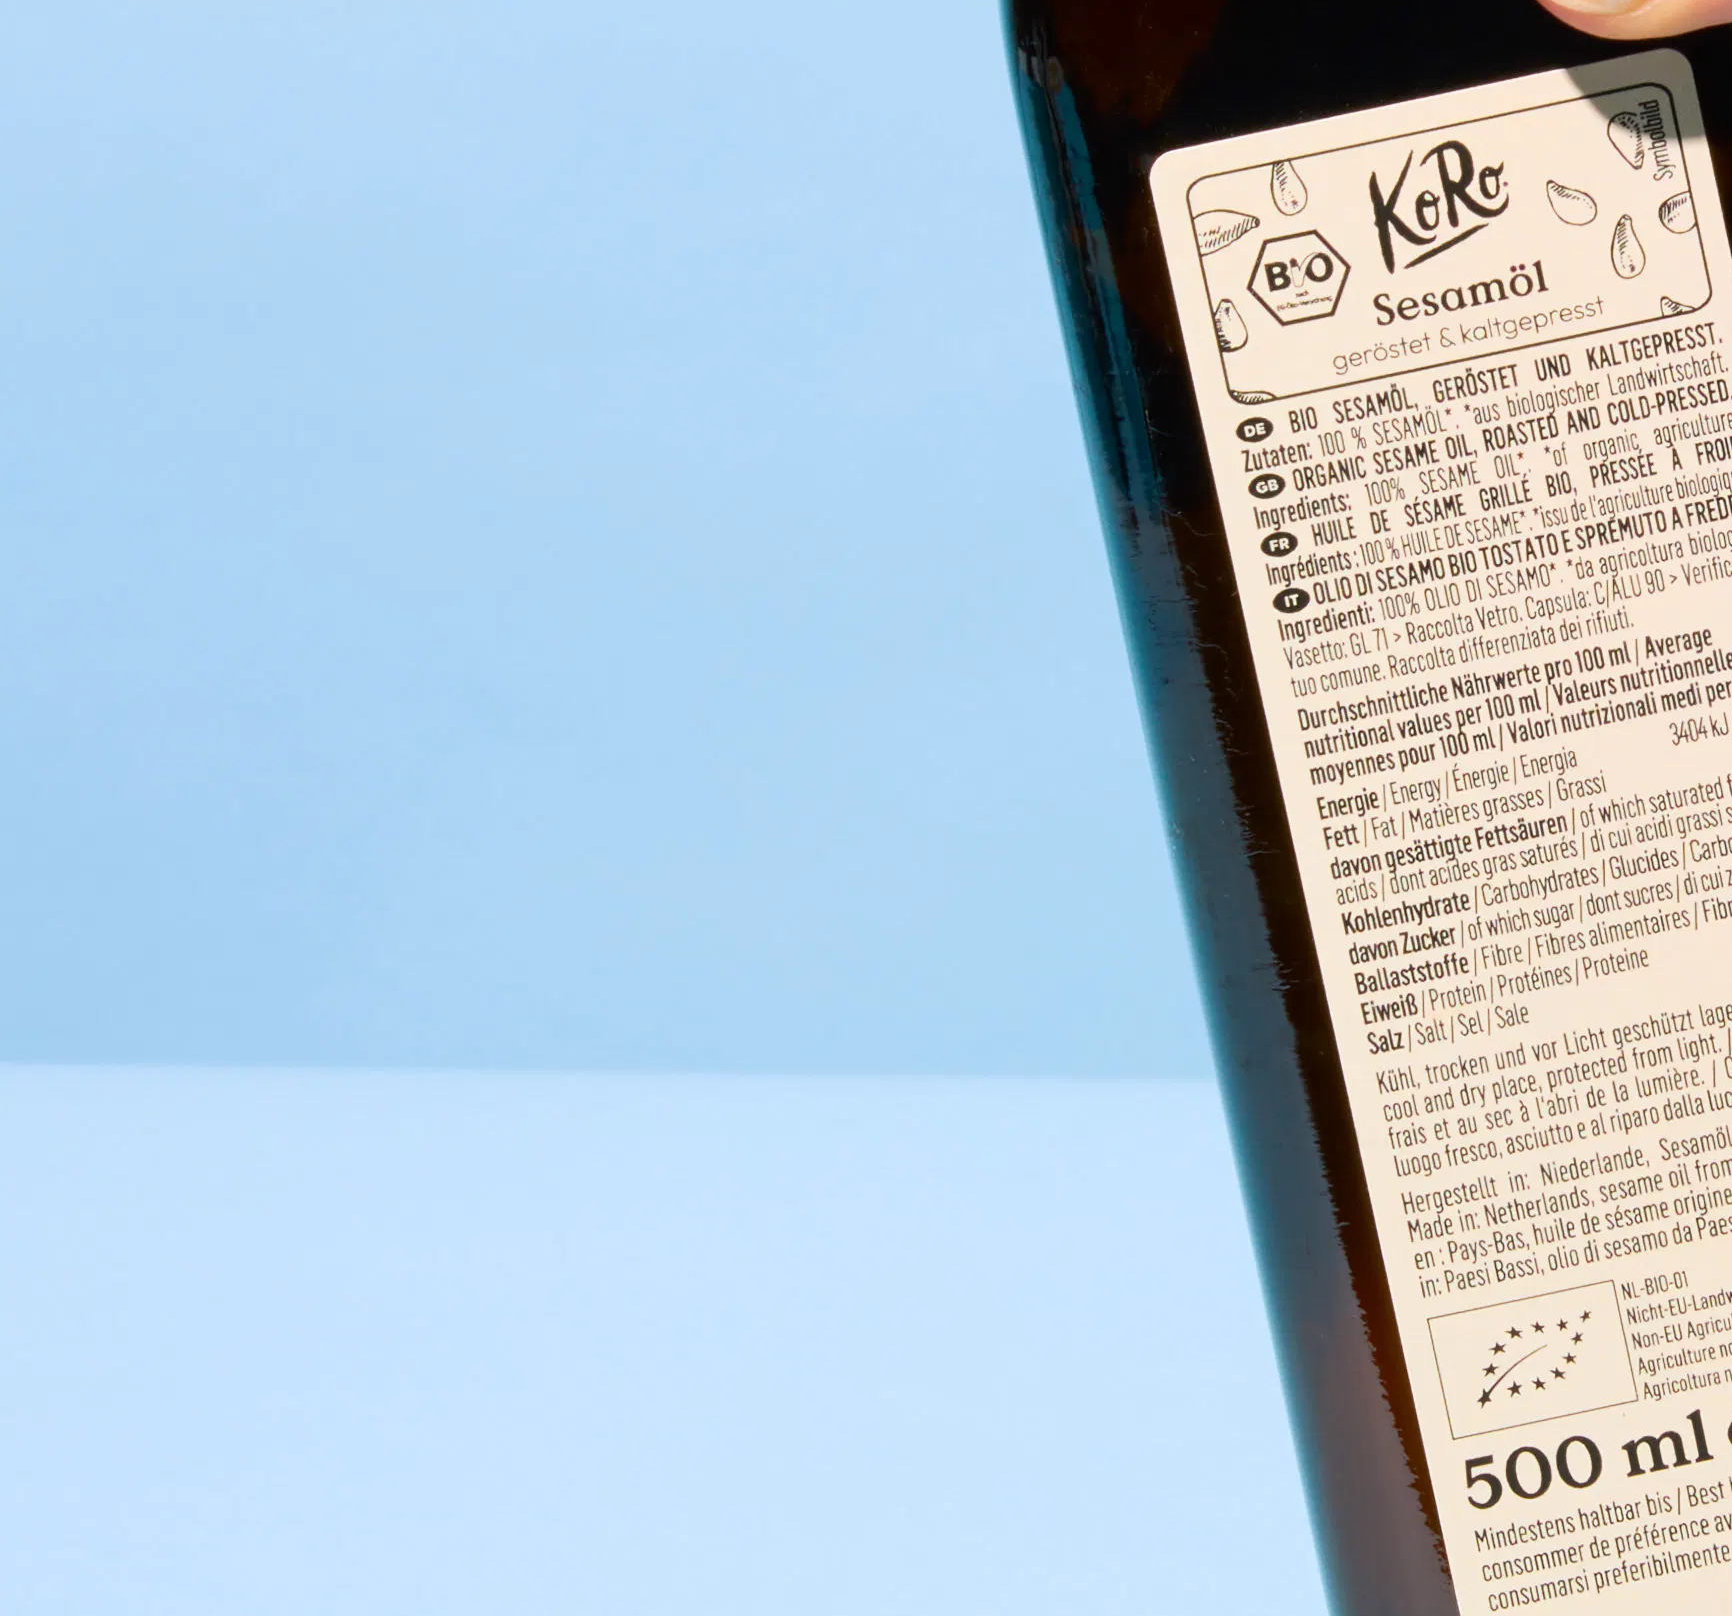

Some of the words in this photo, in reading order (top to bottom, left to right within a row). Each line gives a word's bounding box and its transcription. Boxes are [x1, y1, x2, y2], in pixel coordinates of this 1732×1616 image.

[1638, 99, 1676, 181] Symbolbild
[1369, 140, 1509, 275] KoRo
[1371, 258, 1550, 327] Sesamöl
[1332, 331, 1431, 376] geröstet
[1438, 326, 1457, 348] &
[1458, 295, 1604, 344] kaltgepresst
[1242, 420, 1268, 439] DE
[1287, 405, 1319, 434] BIO
[1331, 381, 1419, 425] SESAMÖL,
[1431, 362, 1519, 404] GERÖSTET
[1533, 352, 1572, 382] UND
[1584, 320, 1723, 372] KALTGEPRESST.
[1253, 476, 1280, 495] GB
[1291, 454, 1368, 492] ORGANIC
[1371, 438, 1441, 476] SESAME
[1443, 432, 1478, 460] OIL,
[1480, 412, 1560, 453] ROASTED
[1566, 404, 1602, 436] AND
[1267, 535, 1291, 553] FR
[1309, 515, 1358, 547] HUILE
[1368, 508, 1392, 535] DE
[1400, 485, 1467, 528] SÉSAME
[1475, 471, 1534, 512] GRILLÉ
[1543, 469, 1578, 498] BIO,
[1586, 447, 1658, 489] PRESSÉE
[1667, 441, 1684, 472] À
[1282, 592, 1301, 608] IT
[1311, 575, 1353, 605] OLIO
[1353, 570, 1374, 597] DI
[1374, 555, 1446, 593] SESAMO
[1446, 549, 1478, 578] BIO
[1477, 531, 1560, 571] TOSTATO
[1559, 528, 1574, 554] E
[1573, 508, 1668, 551] SPREMUTO
[1671, 505, 1685, 531] A
[1289, 675, 1318, 698] tuo
[1318, 662, 1387, 693] comune.
[1386, 645, 1457, 679] Raccolta
[1457, 624, 1557, 664] differenziata
[1558, 614, 1583, 643] dei
[1584, 604, 1635, 637] rifiuti.
[1296, 681, 1450, 732] Durchschnittliche
[1449, 662, 1542, 700] Nährwerte
[1542, 657, 1576, 687] pro
[1573, 645, 1606, 674] 100
[1607, 639, 1632, 667] ml
[1644, 627, 1716, 666] Average
[1668, 715, 1709, 746] 3404
[1707, 711, 1730, 738] kJ
[1315, 786, 1381, 821] Energie
[1388, 777, 1441, 806] Energy
[1450, 759, 1510, 793] Énergie
[1518, 745, 1578, 779] Energia
[1321, 822, 1361, 851] Fett
[1369, 815, 1399, 840] Fat
[1407, 801, 1481, 833] Matières
[1481, 787, 1545, 823] grasses
[1554, 768, 1607, 802] Grassi
[1340, 891, 1472, 936] Kohlenhydrate
[1480, 865, 1600, 907] Carbohydrates
[1607, 846, 1680, 880] Glucides
[1352, 951, 1470, 996] Ballaststoffe
[1479, 942, 1524, 970] Fibre
[1533, 930, 1587, 958] Fibres
[1587, 907, 1692, 948] alimentaires
[1359, 991, 1419, 1026] Eiweiß
[1427, 978, 1487, 1012] Protein
[1495, 964, 1573, 998] Protéines
[1580, 946, 1650, 980] Proteine
[1365, 1027, 1406, 1056] Salz
[1413, 1017, 1448, 1046] Salt
[1456, 1009, 1485, 1037] Sel
[1493, 1001, 1530, 1030] Sale
[1374, 1064, 1421, 1095] Kühl,
[1423, 1054, 1490, 1085] trocken
[1493, 1041, 1527, 1071] und
[1530, 1040, 1558, 1063] vor
[1562, 1026, 1608, 1056] Licht
[1611, 1008, 1695, 1052] geschützt
[1399, 1174, 1499, 1216] Hergestellt
[1506, 1170, 1531, 1193] in:
[1538, 1144, 1650, 1187] Niederlande,
[1620, 1269, 1689, 1301] NL-BIO-01
[1630, 1322, 1683, 1350] Non-EU
[1637, 1345, 1717, 1377] Agriculture
[1642, 1370, 1722, 1402] Agricoltura
[1463, 1434, 1603, 1510] 500
[1620, 1407, 1715, 1478] ml
[1473, 1515, 1576, 1553] Mindestens
[1576, 1500, 1642, 1531] haltbar
[1643, 1490, 1674, 1516] bis
[1685, 1480, 1725, 1508] Best
[1481, 1543, 1585, 1583] consommer
[1588, 1534, 1612, 1560] de
[1613, 1517, 1711, 1559] préférence
[1487, 1567, 1590, 1612] consumarsi
[1592, 1542, 1732, 1594] preferibilmente
